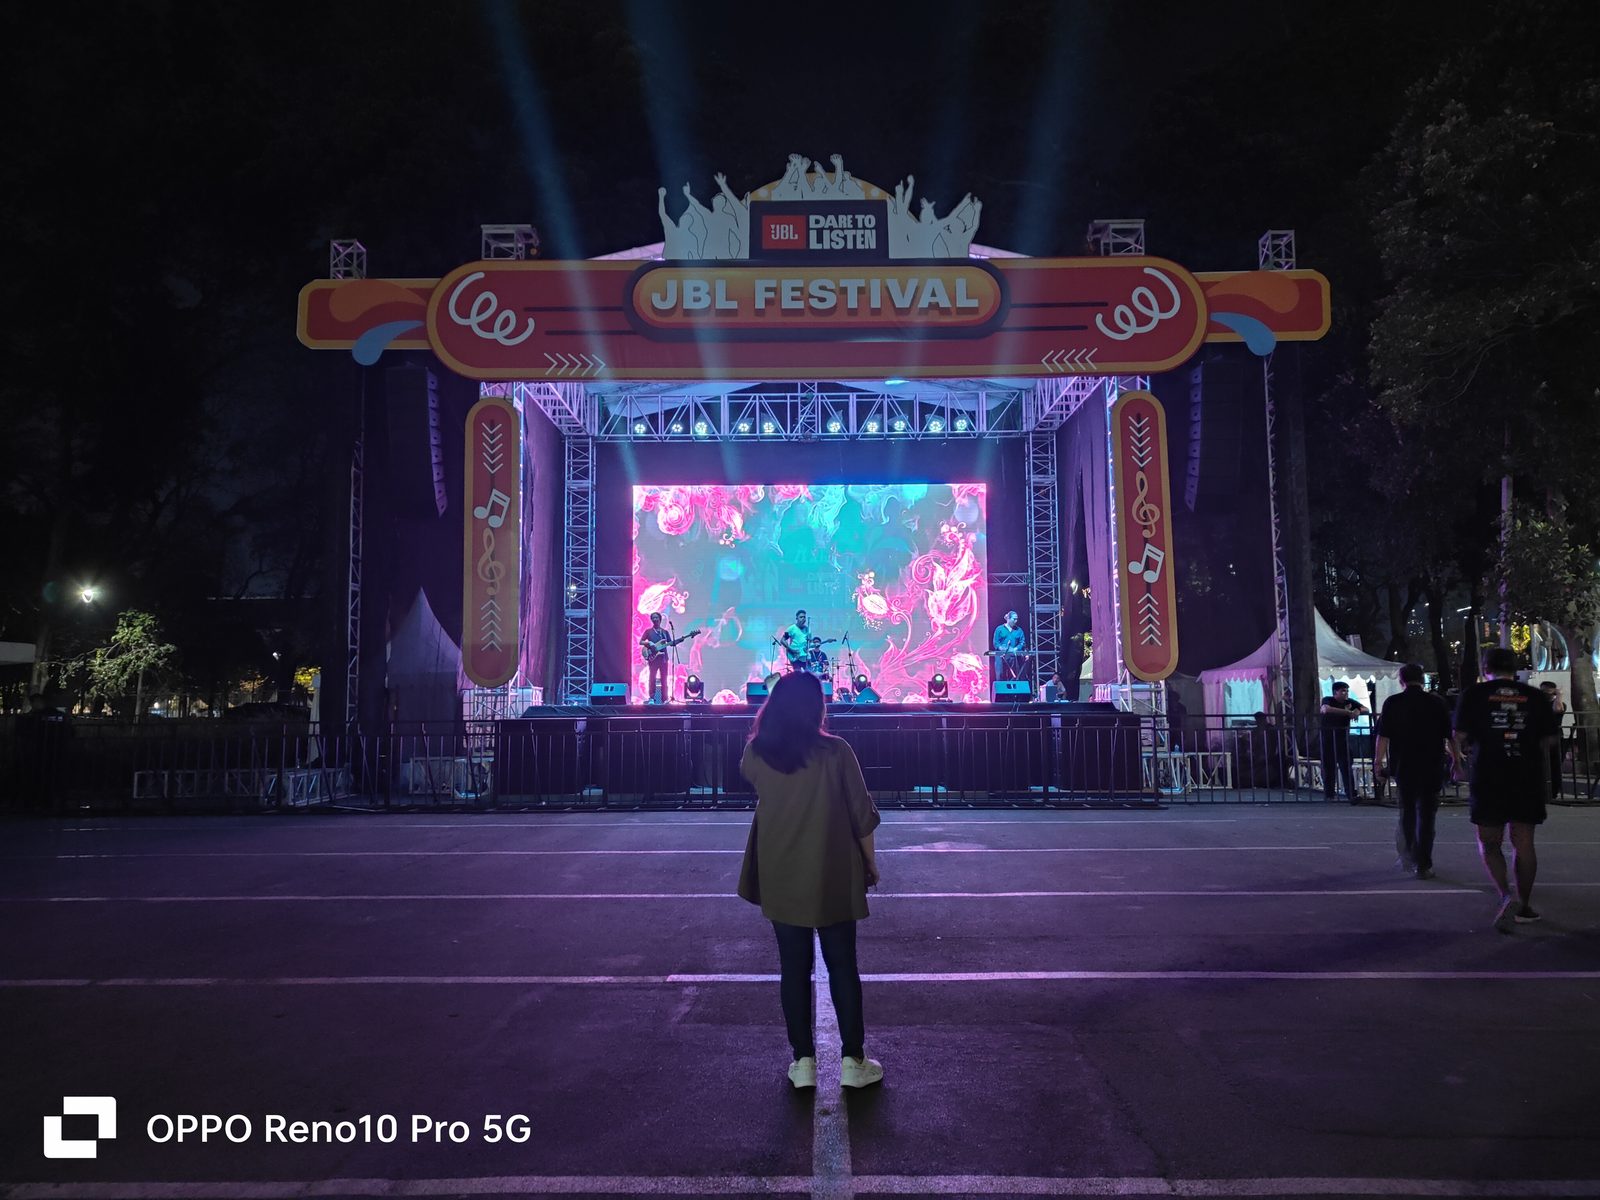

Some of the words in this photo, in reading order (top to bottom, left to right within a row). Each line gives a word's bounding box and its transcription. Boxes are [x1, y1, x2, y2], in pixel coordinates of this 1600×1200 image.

[808, 214, 854, 229] DARE
[854, 214, 876, 228] TO
[770, 224, 799, 240] JBL
[808, 229, 877, 250] LISTEN
[651, 279, 738, 310] JBL
[754, 278, 979, 309] FESTIVAL
